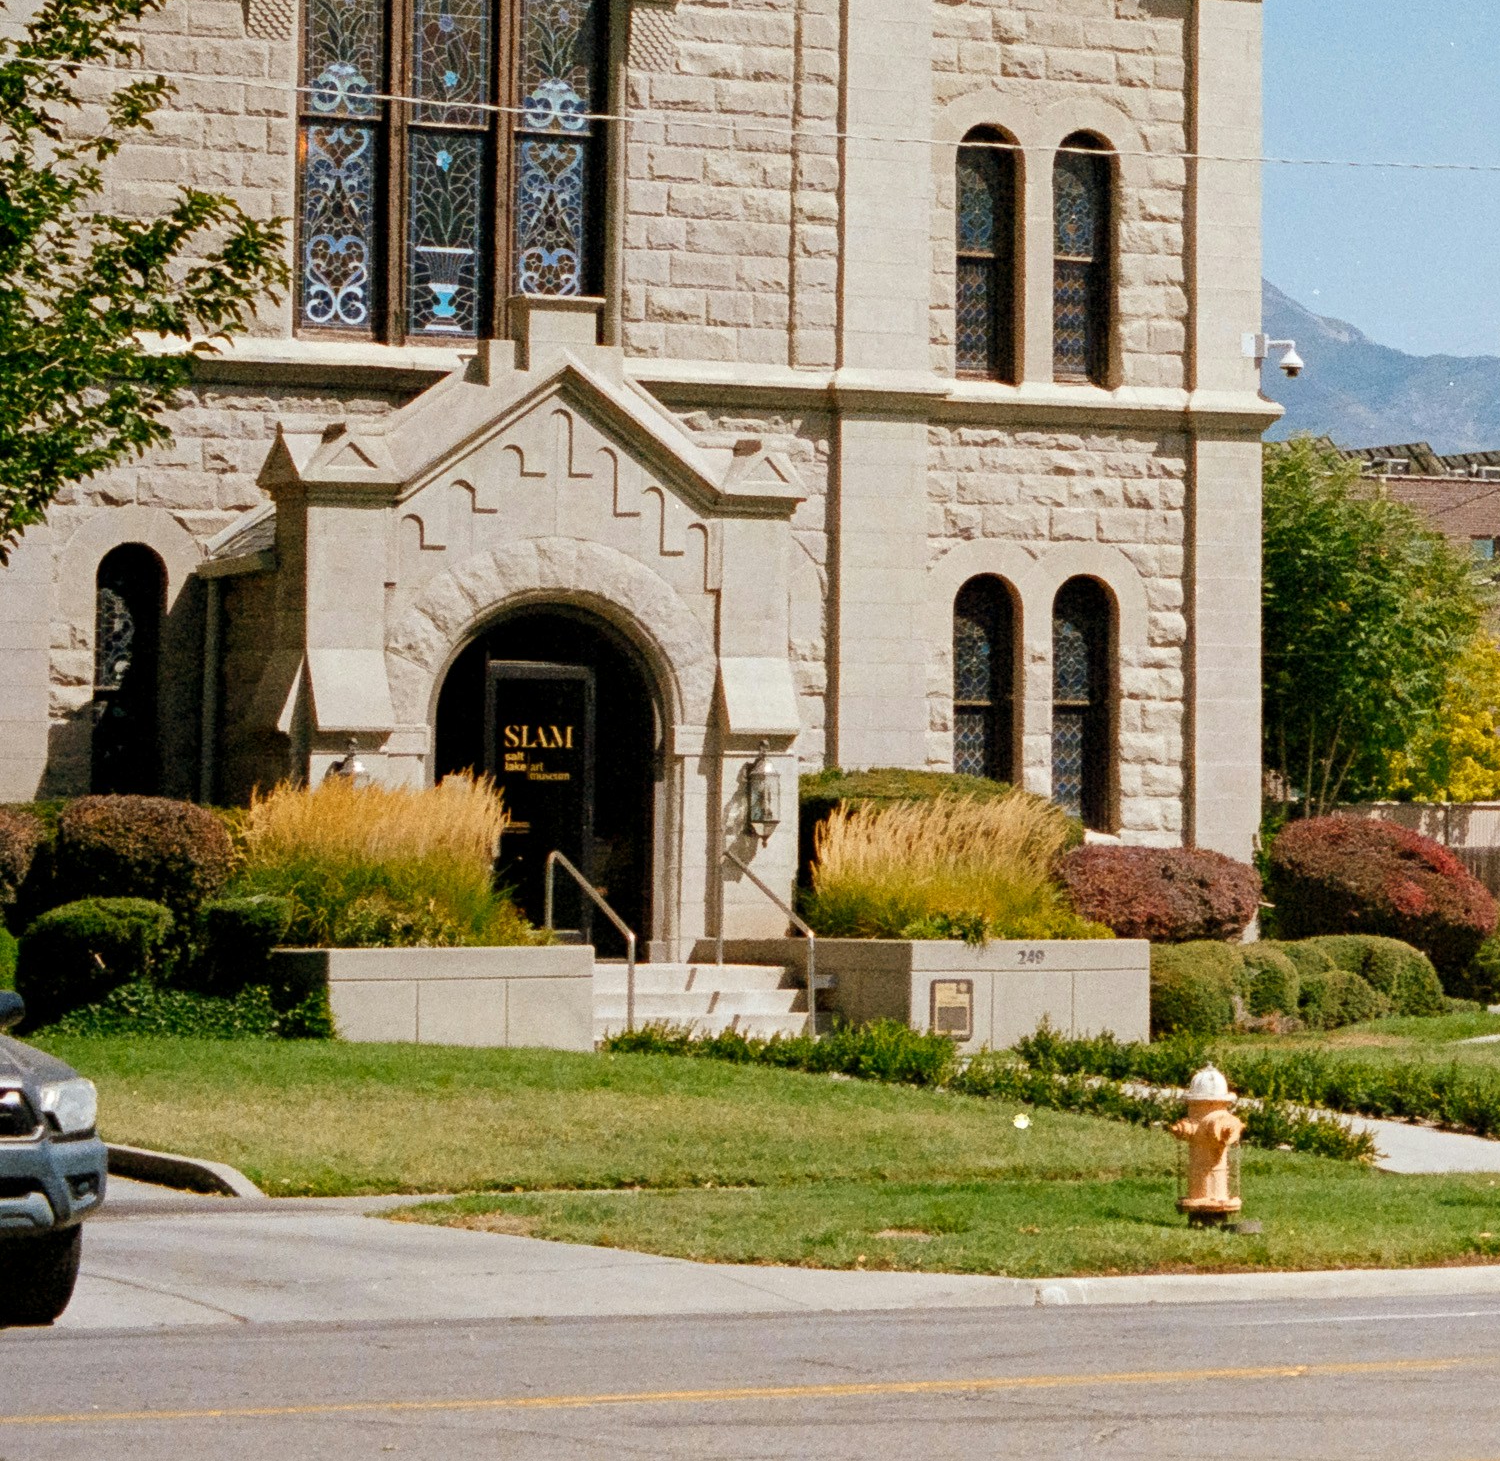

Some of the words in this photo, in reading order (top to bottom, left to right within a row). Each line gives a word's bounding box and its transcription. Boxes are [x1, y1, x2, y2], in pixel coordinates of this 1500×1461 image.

[504, 725, 573, 748] SLAM
[505, 752, 524, 761] salt
[505, 761, 527, 771] lake
[530, 762, 544, 771] art
[1017, 949, 1045, 965] 249
